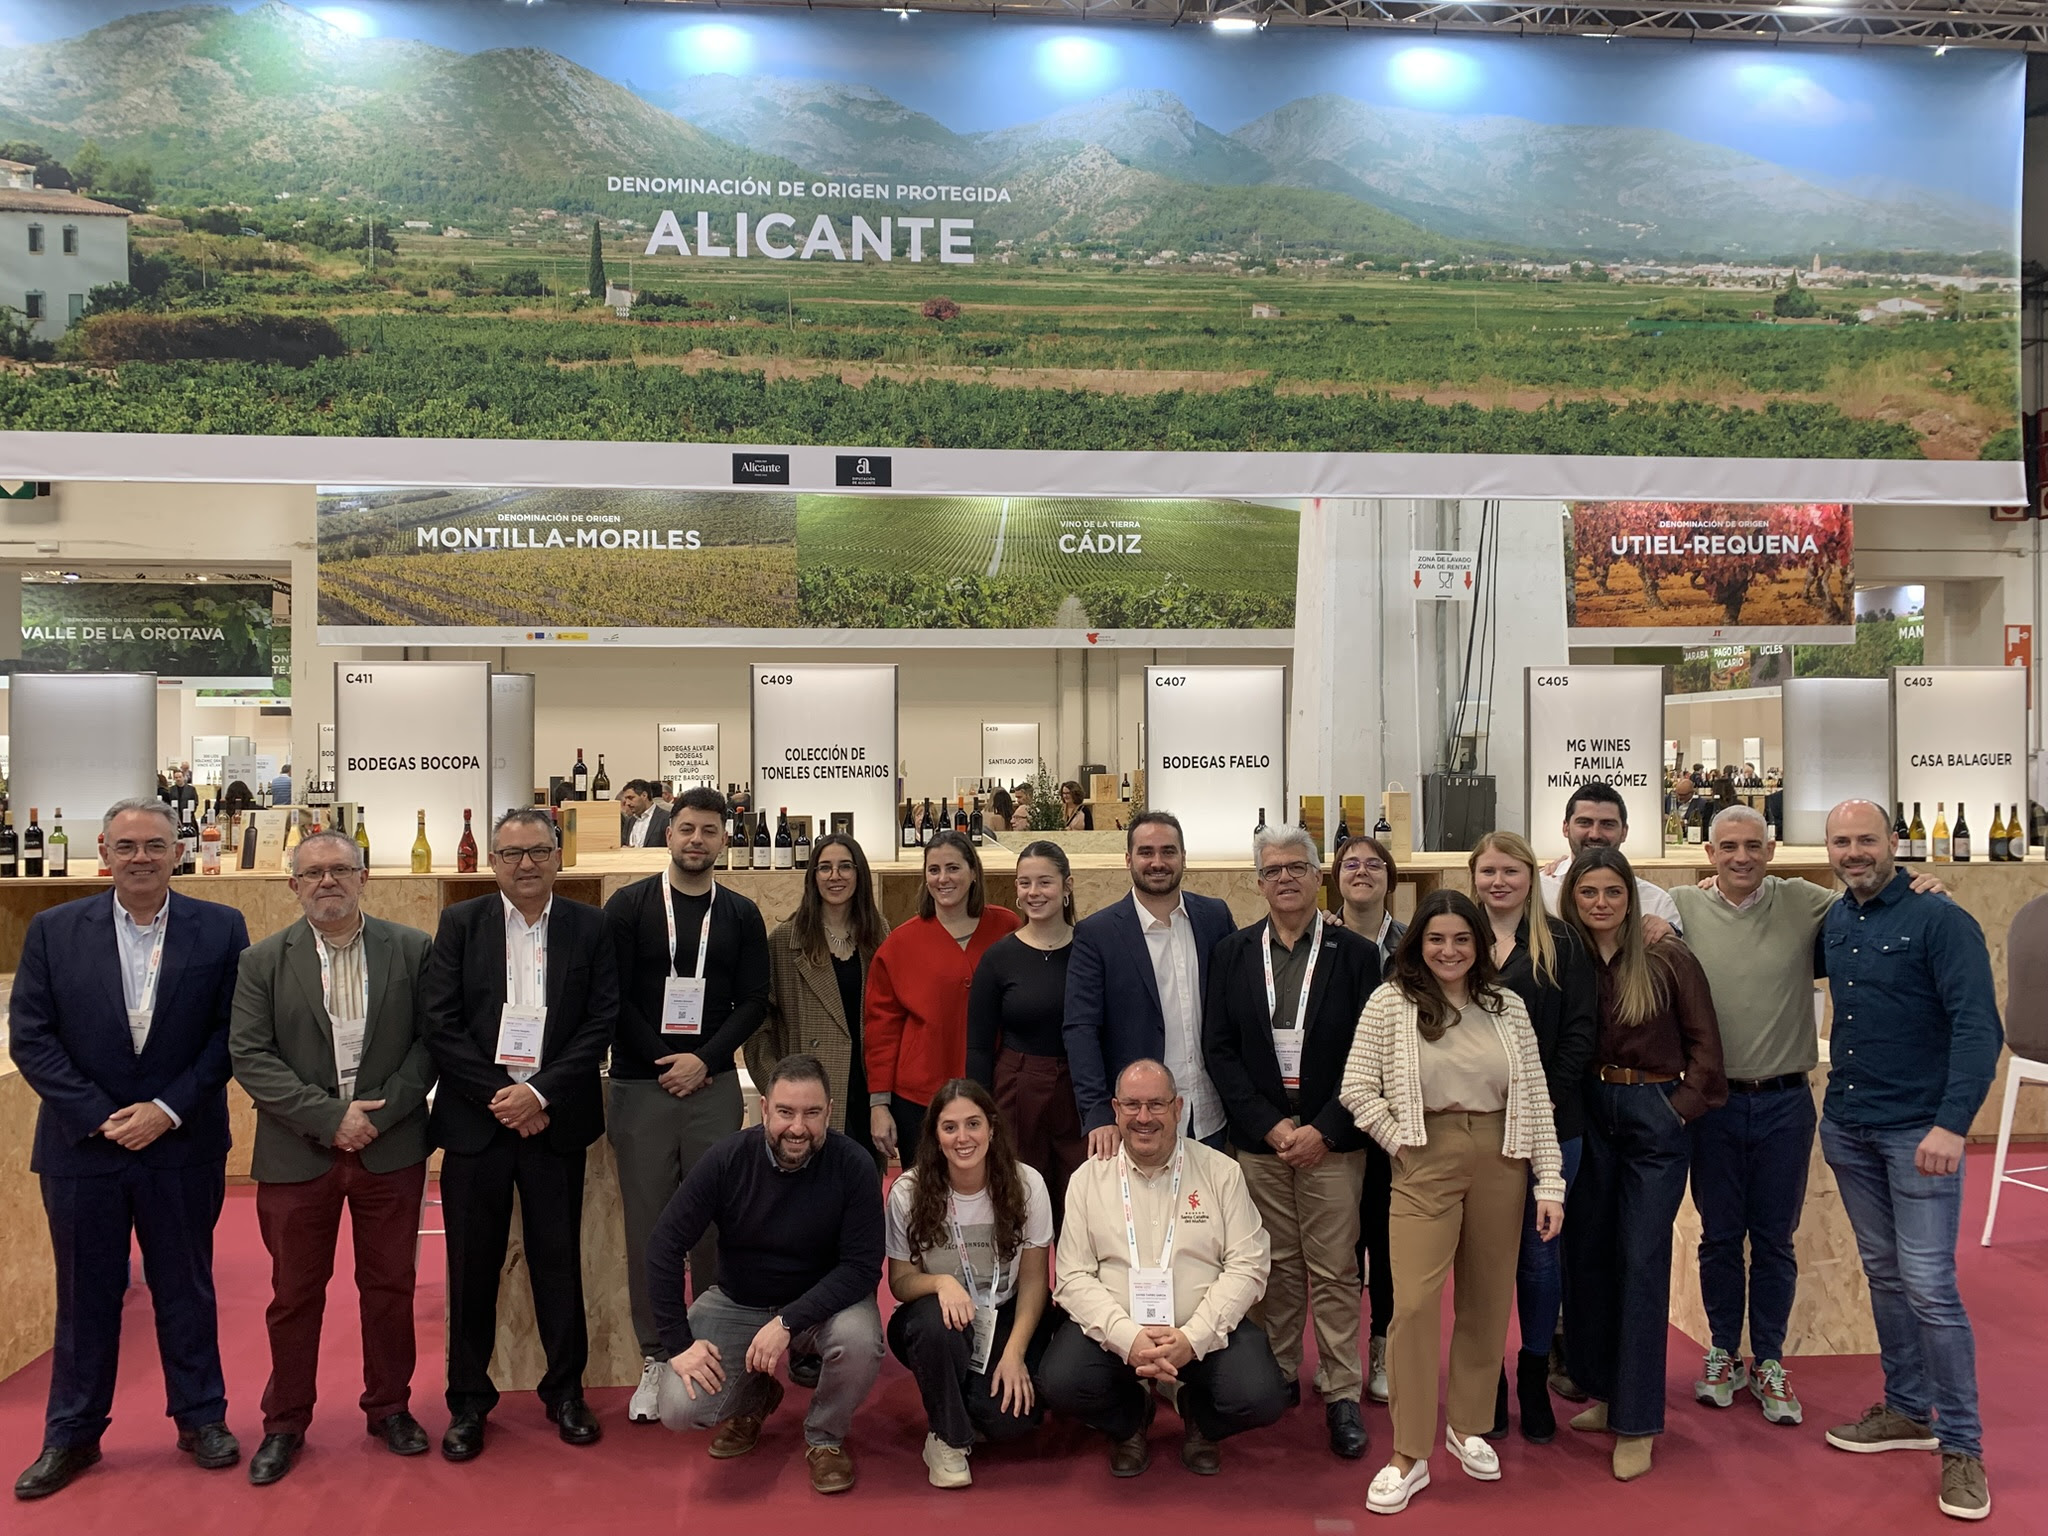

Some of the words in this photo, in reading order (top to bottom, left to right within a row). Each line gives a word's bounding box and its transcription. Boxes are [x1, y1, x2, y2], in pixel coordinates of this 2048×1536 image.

[607, 176, 771, 196] DENOMINACIÓN
[778, 181, 805, 197] DE
[811, 182, 889, 199] ORIGEN
[897, 185, 1011, 203] PROTEGIDA
[644, 210, 975, 264] ALICANTE
[741, 462, 781, 473] Alicante
[498, 513, 569, 523] DENOMINACIÓN
[571, 514, 584, 523] DE
[586, 514, 621, 523] ORIGEN
[1060, 520, 1081, 528] VINO
[1110, 520, 1141, 528] TIERRA
[1660, 519, 1724, 528] DENOMINACIÓN
[1738, 520, 1769, 528] ORIGEN
[417, 527, 702, 550] MONTILLA-MORILES
[1059, 529, 1142, 554] CÁDIZ
[1611, 535, 1819, 556] UTIEL-REQUENA
[21, 626, 77, 640] VALLE
[83, 626, 106, 640] DE
[112, 627, 135, 640] LA
[140, 627, 225, 640] OROTAVA
[1899, 625, 1924, 640] MAN
[1714, 647, 1732, 658] PAGO
[1733, 645, 1747, 656] DEL
[1716, 657, 1745, 669] VICARIO
[346, 673, 373, 684] C411
[761, 675, 793, 685] C409
[1155, 677, 1186, 687] C407
[1537, 676, 1569, 687] C405
[1904, 677, 1933, 687] C403
[1566, 739, 1587, 752] MG
[1590, 739, 1631, 752] WINES
[785, 744, 848, 761] COLECCIÓN
[851, 747, 866, 760] DE
[348, 757, 416, 771] BODEGAS
[421, 755, 480, 770] BOCOPA
[1162, 755, 1226, 769] BODEGAS
[1229, 755, 1270, 768] FAELO
[1574, 757, 1625, 770] FAMILIA
[1911, 754, 1944, 767] CASA
[1948, 753, 2012, 766] BALAGUER
[762, 766, 810, 780] TONELES
[813, 765, 889, 779] CENTENARIOS
[1604, 771, 1648, 787] GÓMEZ
[964, 1241, 990, 1249] OHNSON
